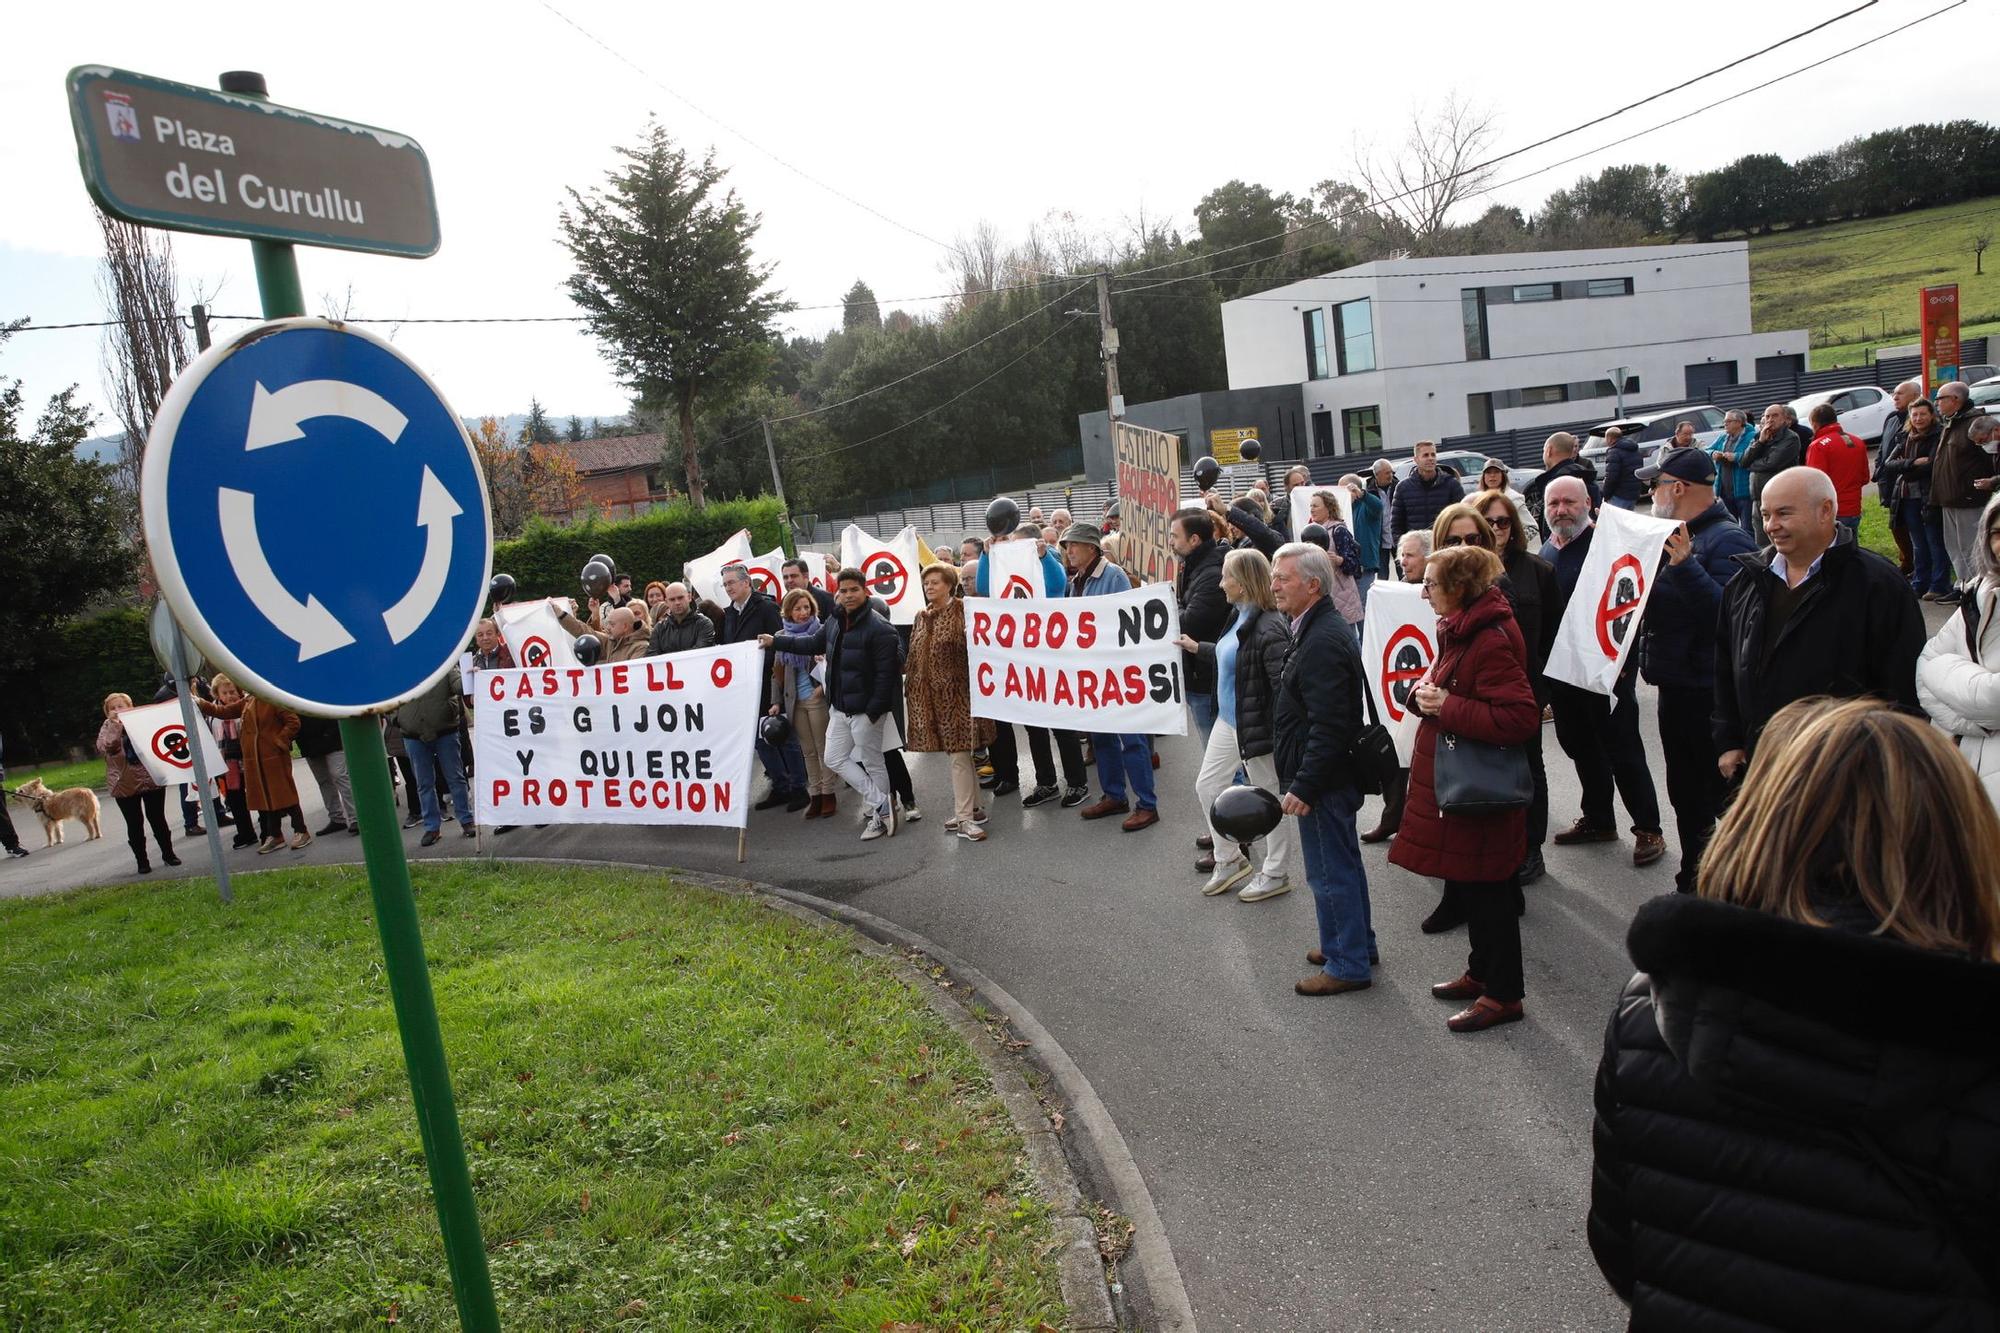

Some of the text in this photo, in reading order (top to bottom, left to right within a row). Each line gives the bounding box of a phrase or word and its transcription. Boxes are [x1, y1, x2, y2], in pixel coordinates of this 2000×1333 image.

[153, 116, 236, 156] Plaza
[165, 162, 364, 225] del Curullu
[1119, 462, 1177, 516] SAQUEADO
[973, 598, 1169, 649] ROBOS NO
[977, 662, 1146, 709] CAMARAS
[503, 706, 546, 737] ES
[516, 749, 713, 780] Y QUIERE
[492, 779, 730, 813] PROTECCION
